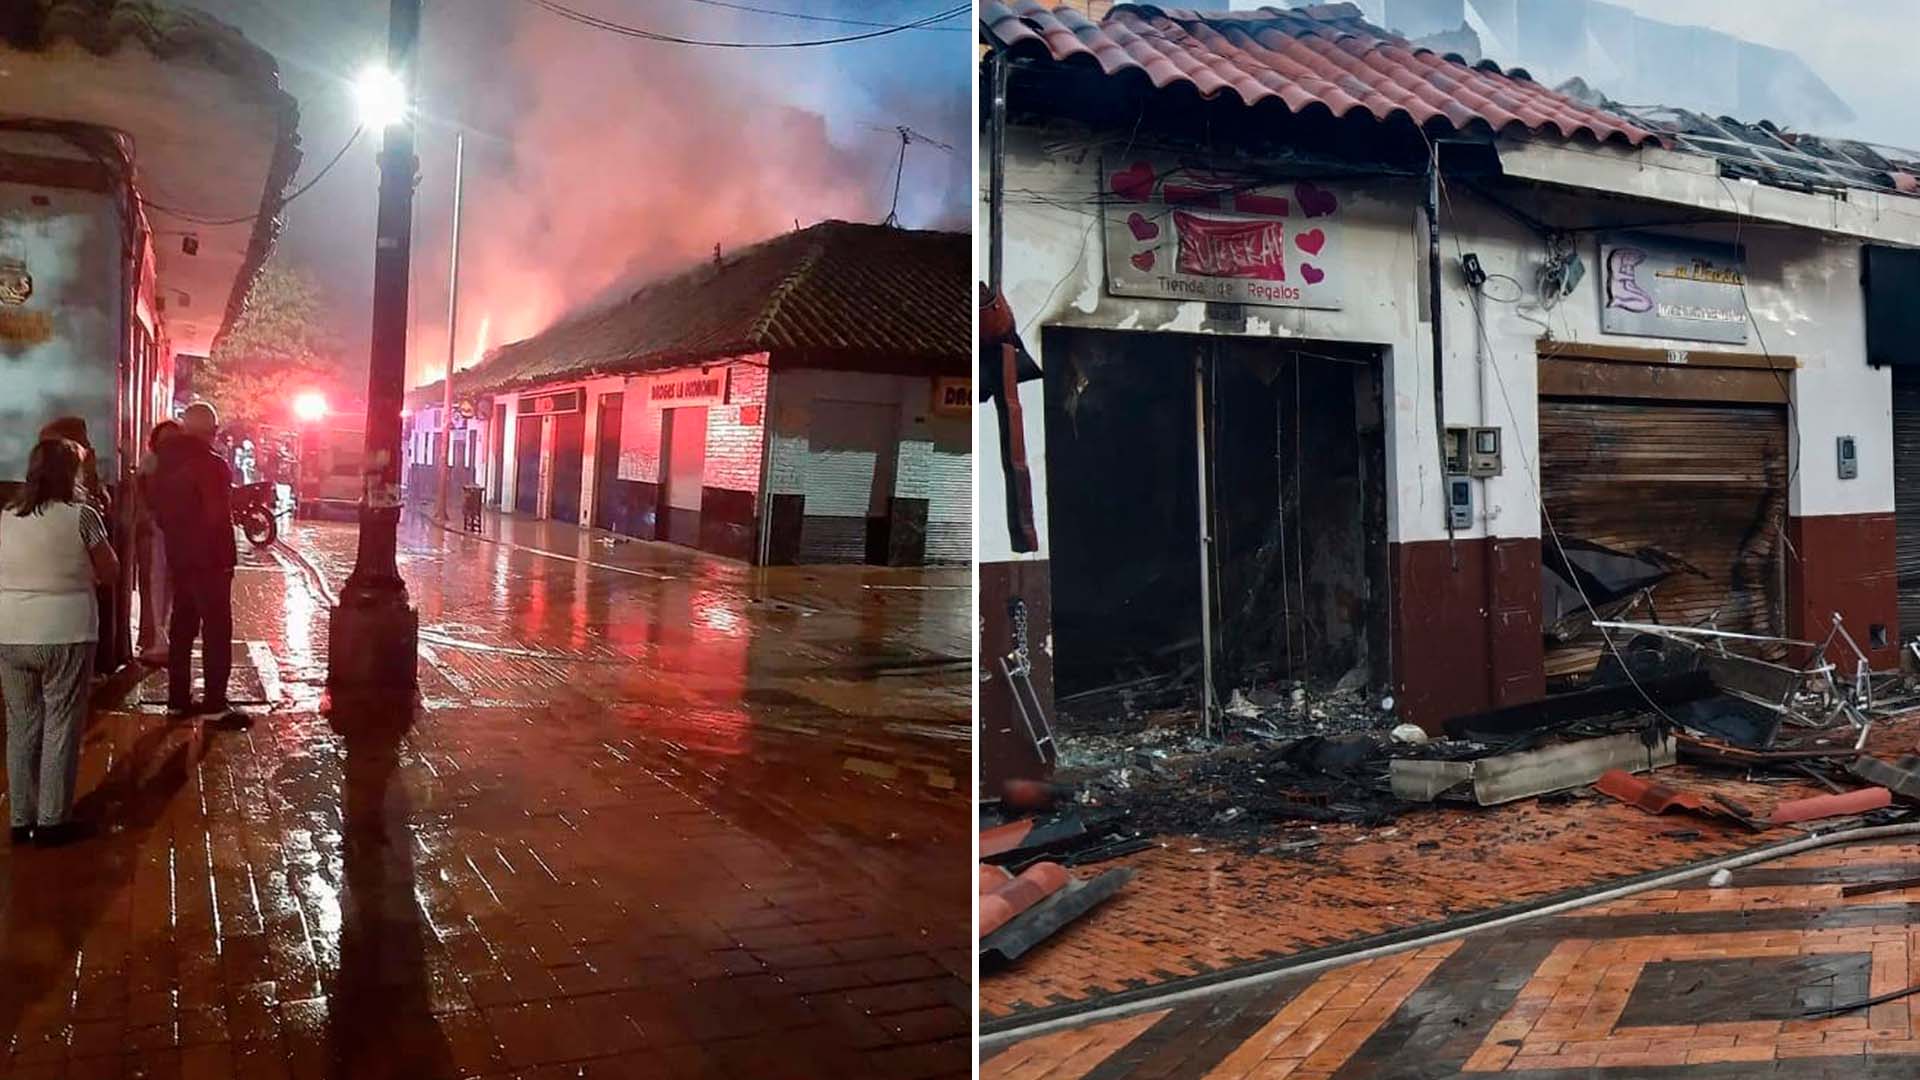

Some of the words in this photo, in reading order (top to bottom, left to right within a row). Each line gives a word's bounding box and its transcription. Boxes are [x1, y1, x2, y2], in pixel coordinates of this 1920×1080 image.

[1157, 276, 1204, 295] Tienda
[1217, 280, 1233, 296] de
[1247, 283, 1300, 301] Regalos
